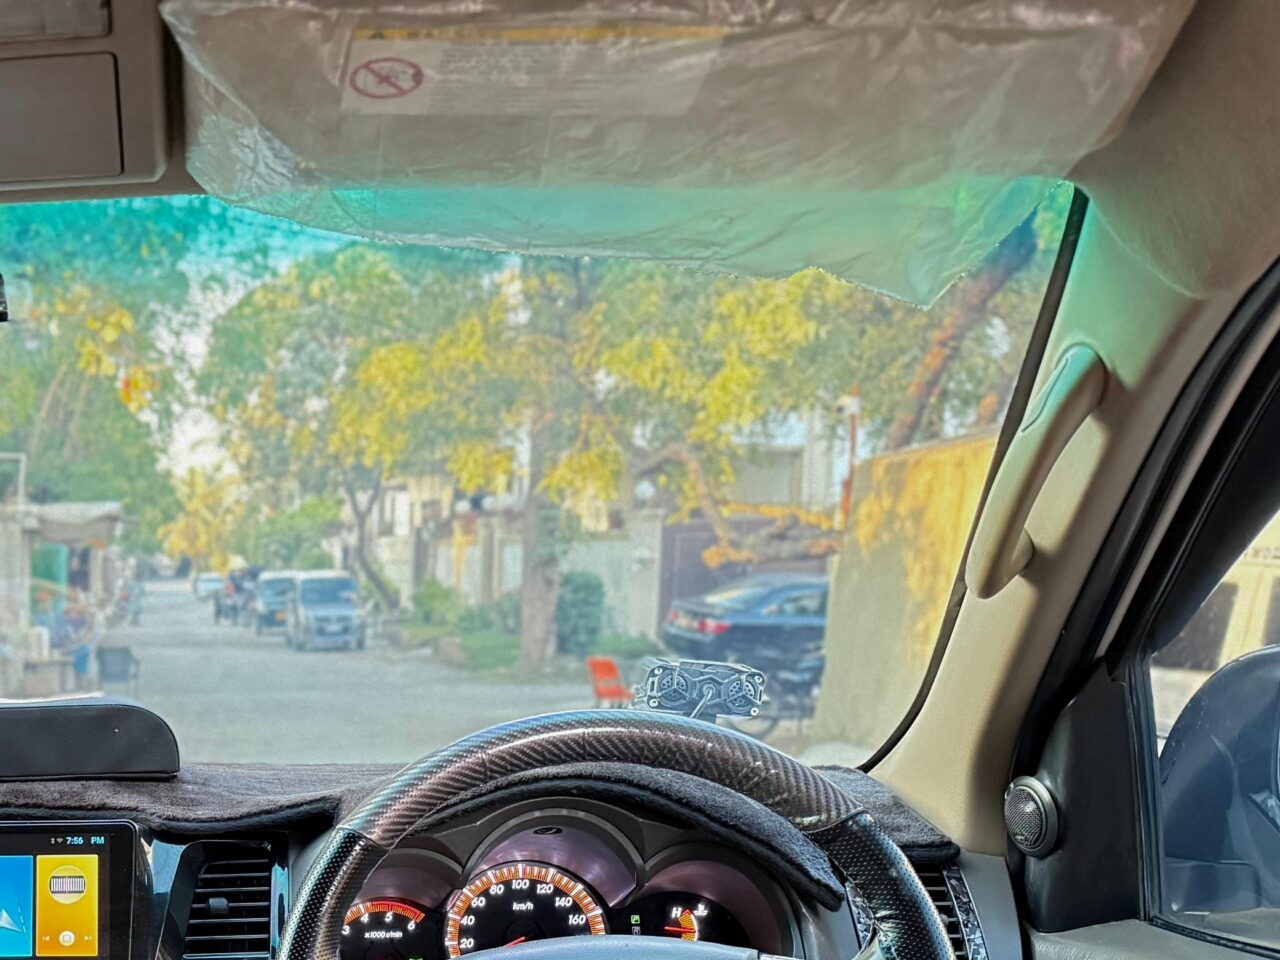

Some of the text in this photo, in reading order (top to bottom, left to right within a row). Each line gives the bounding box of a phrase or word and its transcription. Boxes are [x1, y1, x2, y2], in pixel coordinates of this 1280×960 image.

[66, 836, 105, 845] 7:56 PM
[511, 879, 530, 889] 100
[536, 884, 554, 894] 120
[489, 884, 505, 895] 80
[471, 897, 486, 907] 60
[512, 902, 534, 910] km/h
[555, 897, 573, 907] 140
[360, 912, 369, 923] 4
[384, 911, 393, 922] 5
[671, 907, 682, 918] H
[407, 920, 416, 930] 6
[461, 915, 475, 925] 40
[568, 915, 586, 925] 160
[341, 925, 351, 935] 3
[459, 938, 474, 948] 20
